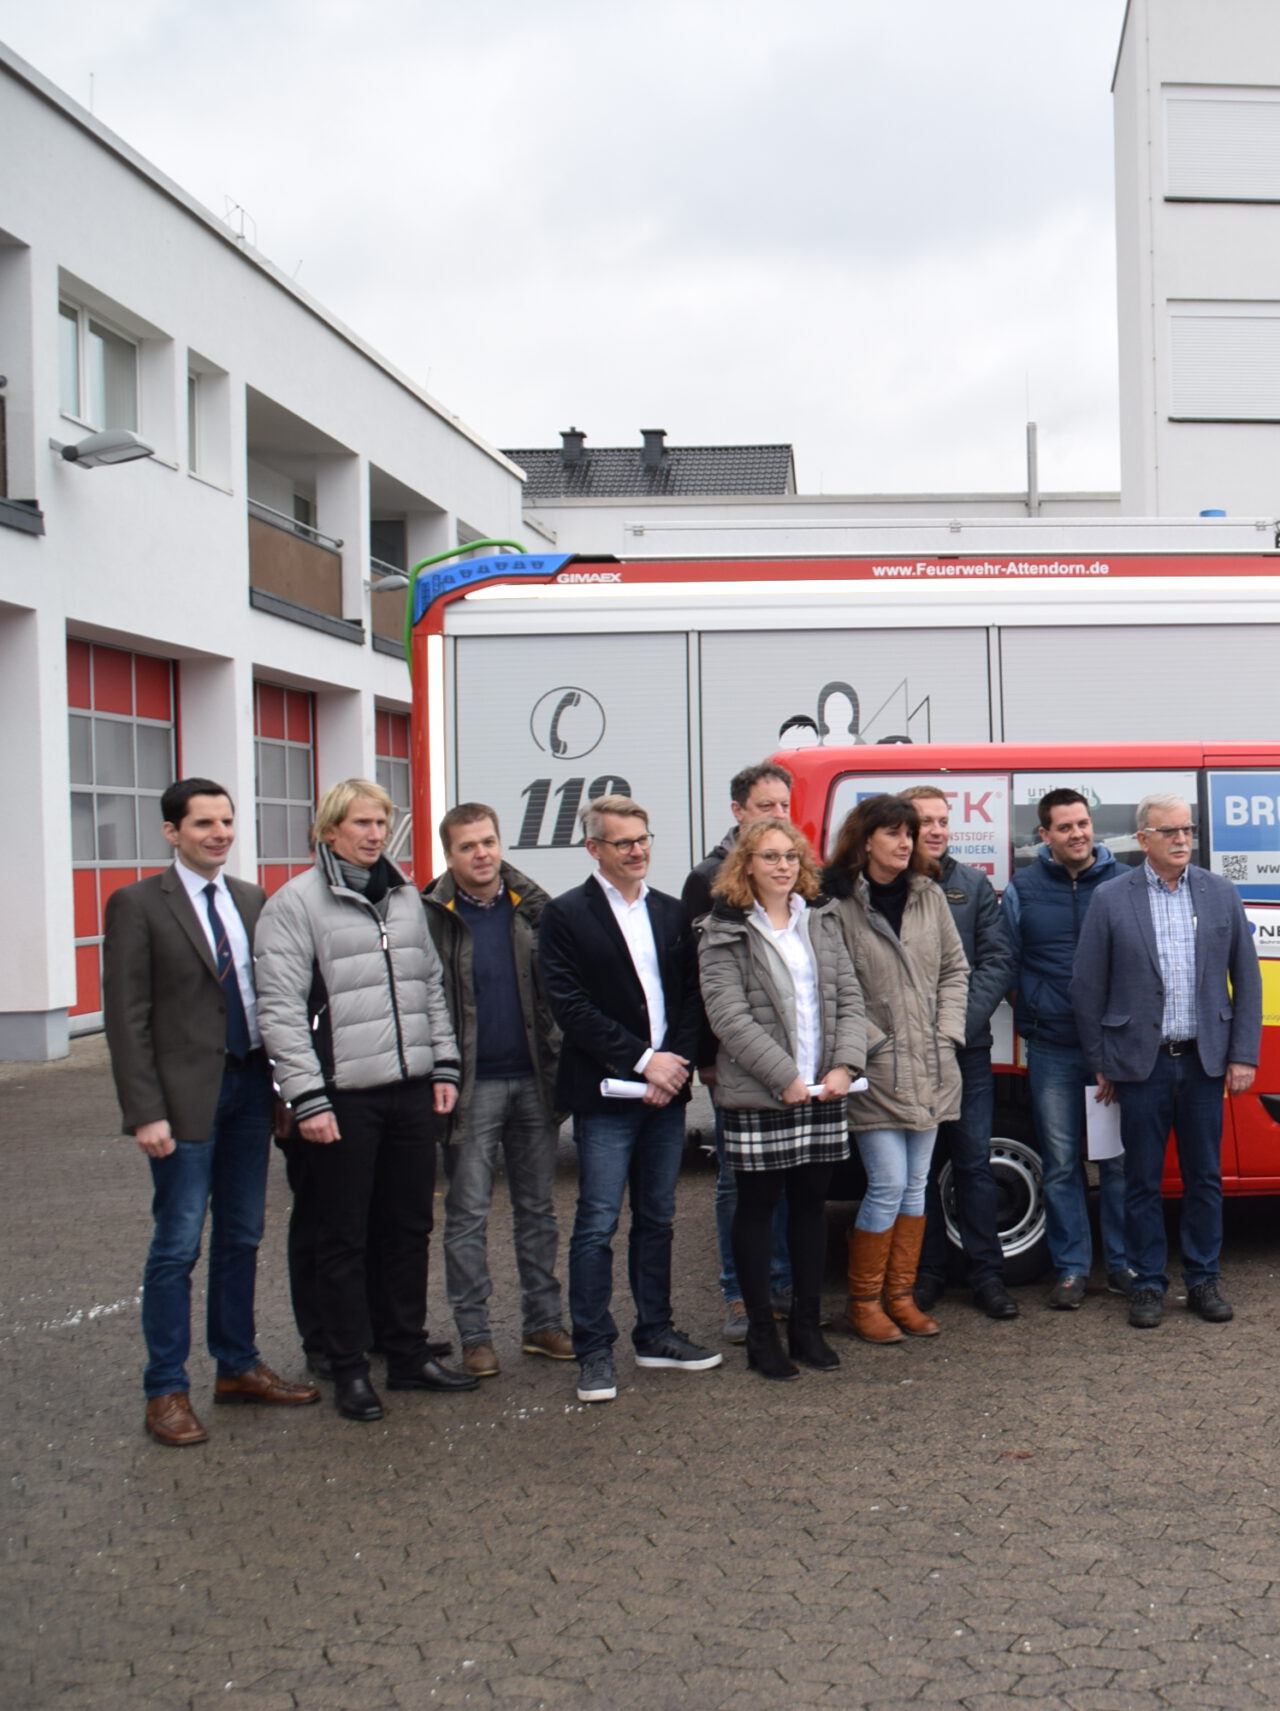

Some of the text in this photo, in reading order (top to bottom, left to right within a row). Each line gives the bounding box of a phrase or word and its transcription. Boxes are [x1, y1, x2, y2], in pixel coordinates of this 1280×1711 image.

[872, 561, 1109, 577] www.Feuerwehr-Attendorn.de
[556, 572, 621, 584] GIMAEX
[948, 845, 997, 855] ON IDEEN.
